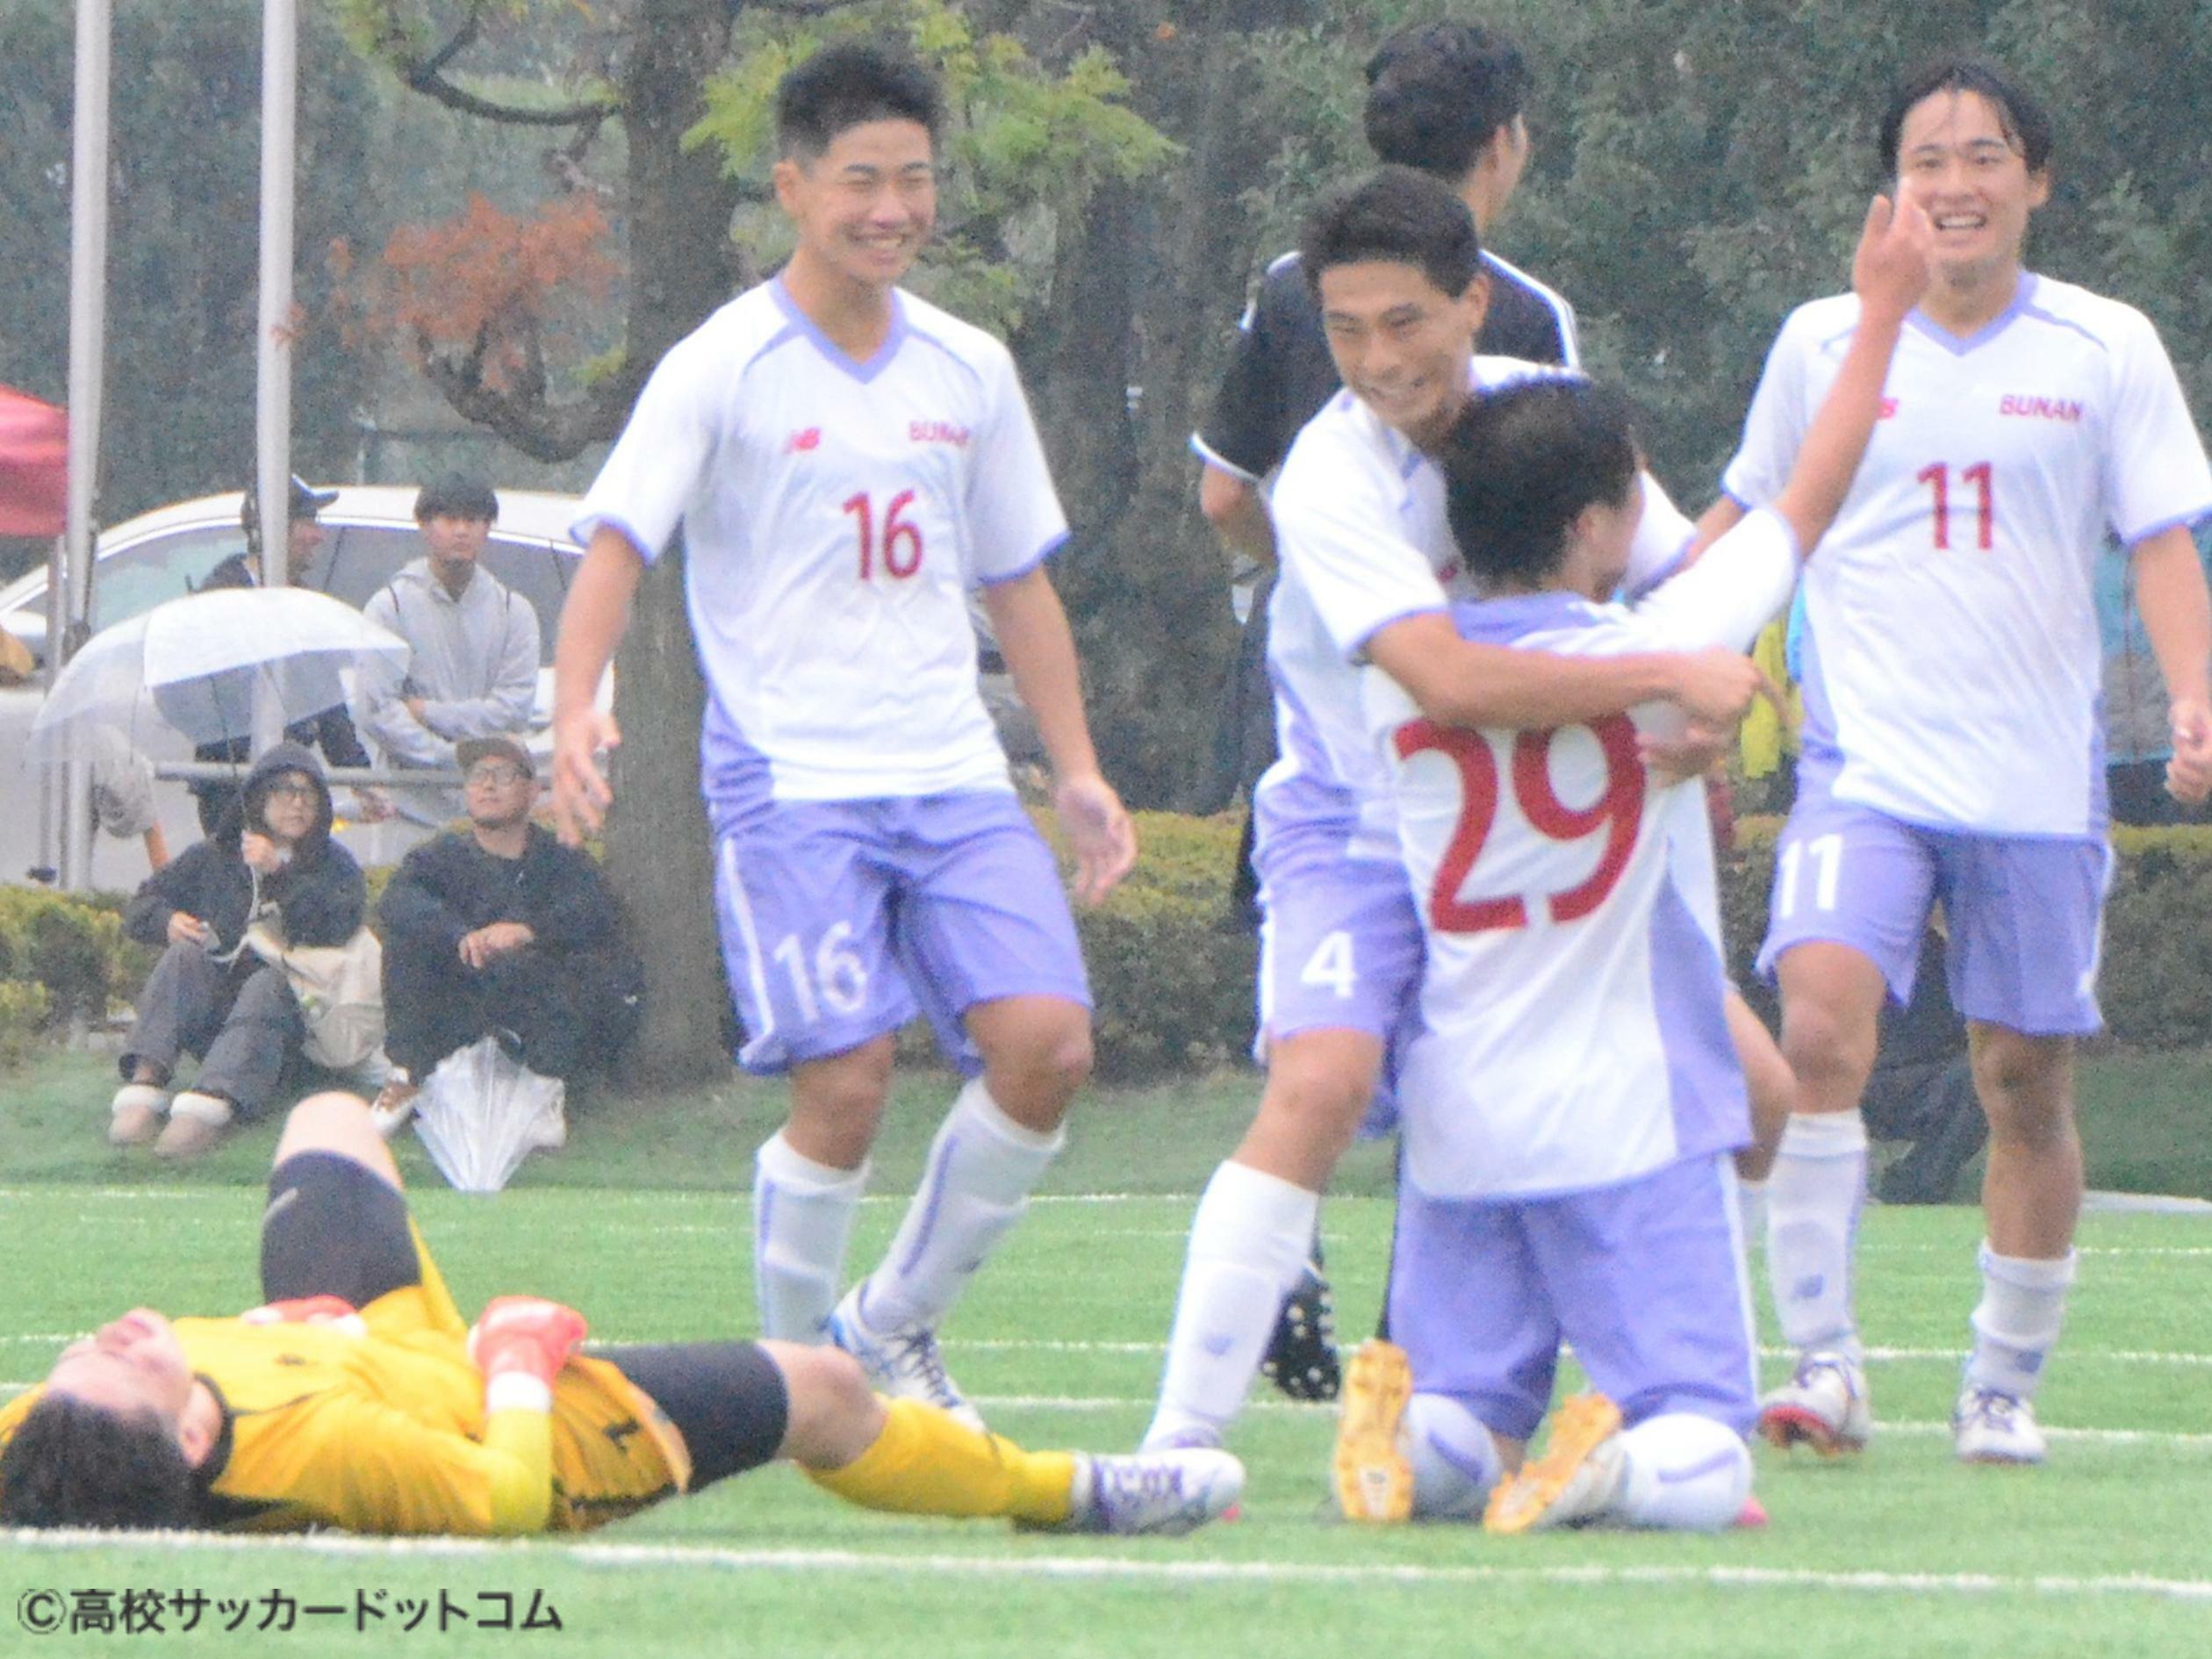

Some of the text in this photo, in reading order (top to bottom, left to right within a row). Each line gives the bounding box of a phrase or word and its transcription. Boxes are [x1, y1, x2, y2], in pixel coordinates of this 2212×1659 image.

[843, 489, 923, 580] 16
[1916, 461, 1993, 549] 11
[1394, 714, 1647, 932] 29
[1780, 833, 1842, 917] 11
[773, 921, 868, 1023] 16
[1300, 930, 1357, 999] 4
